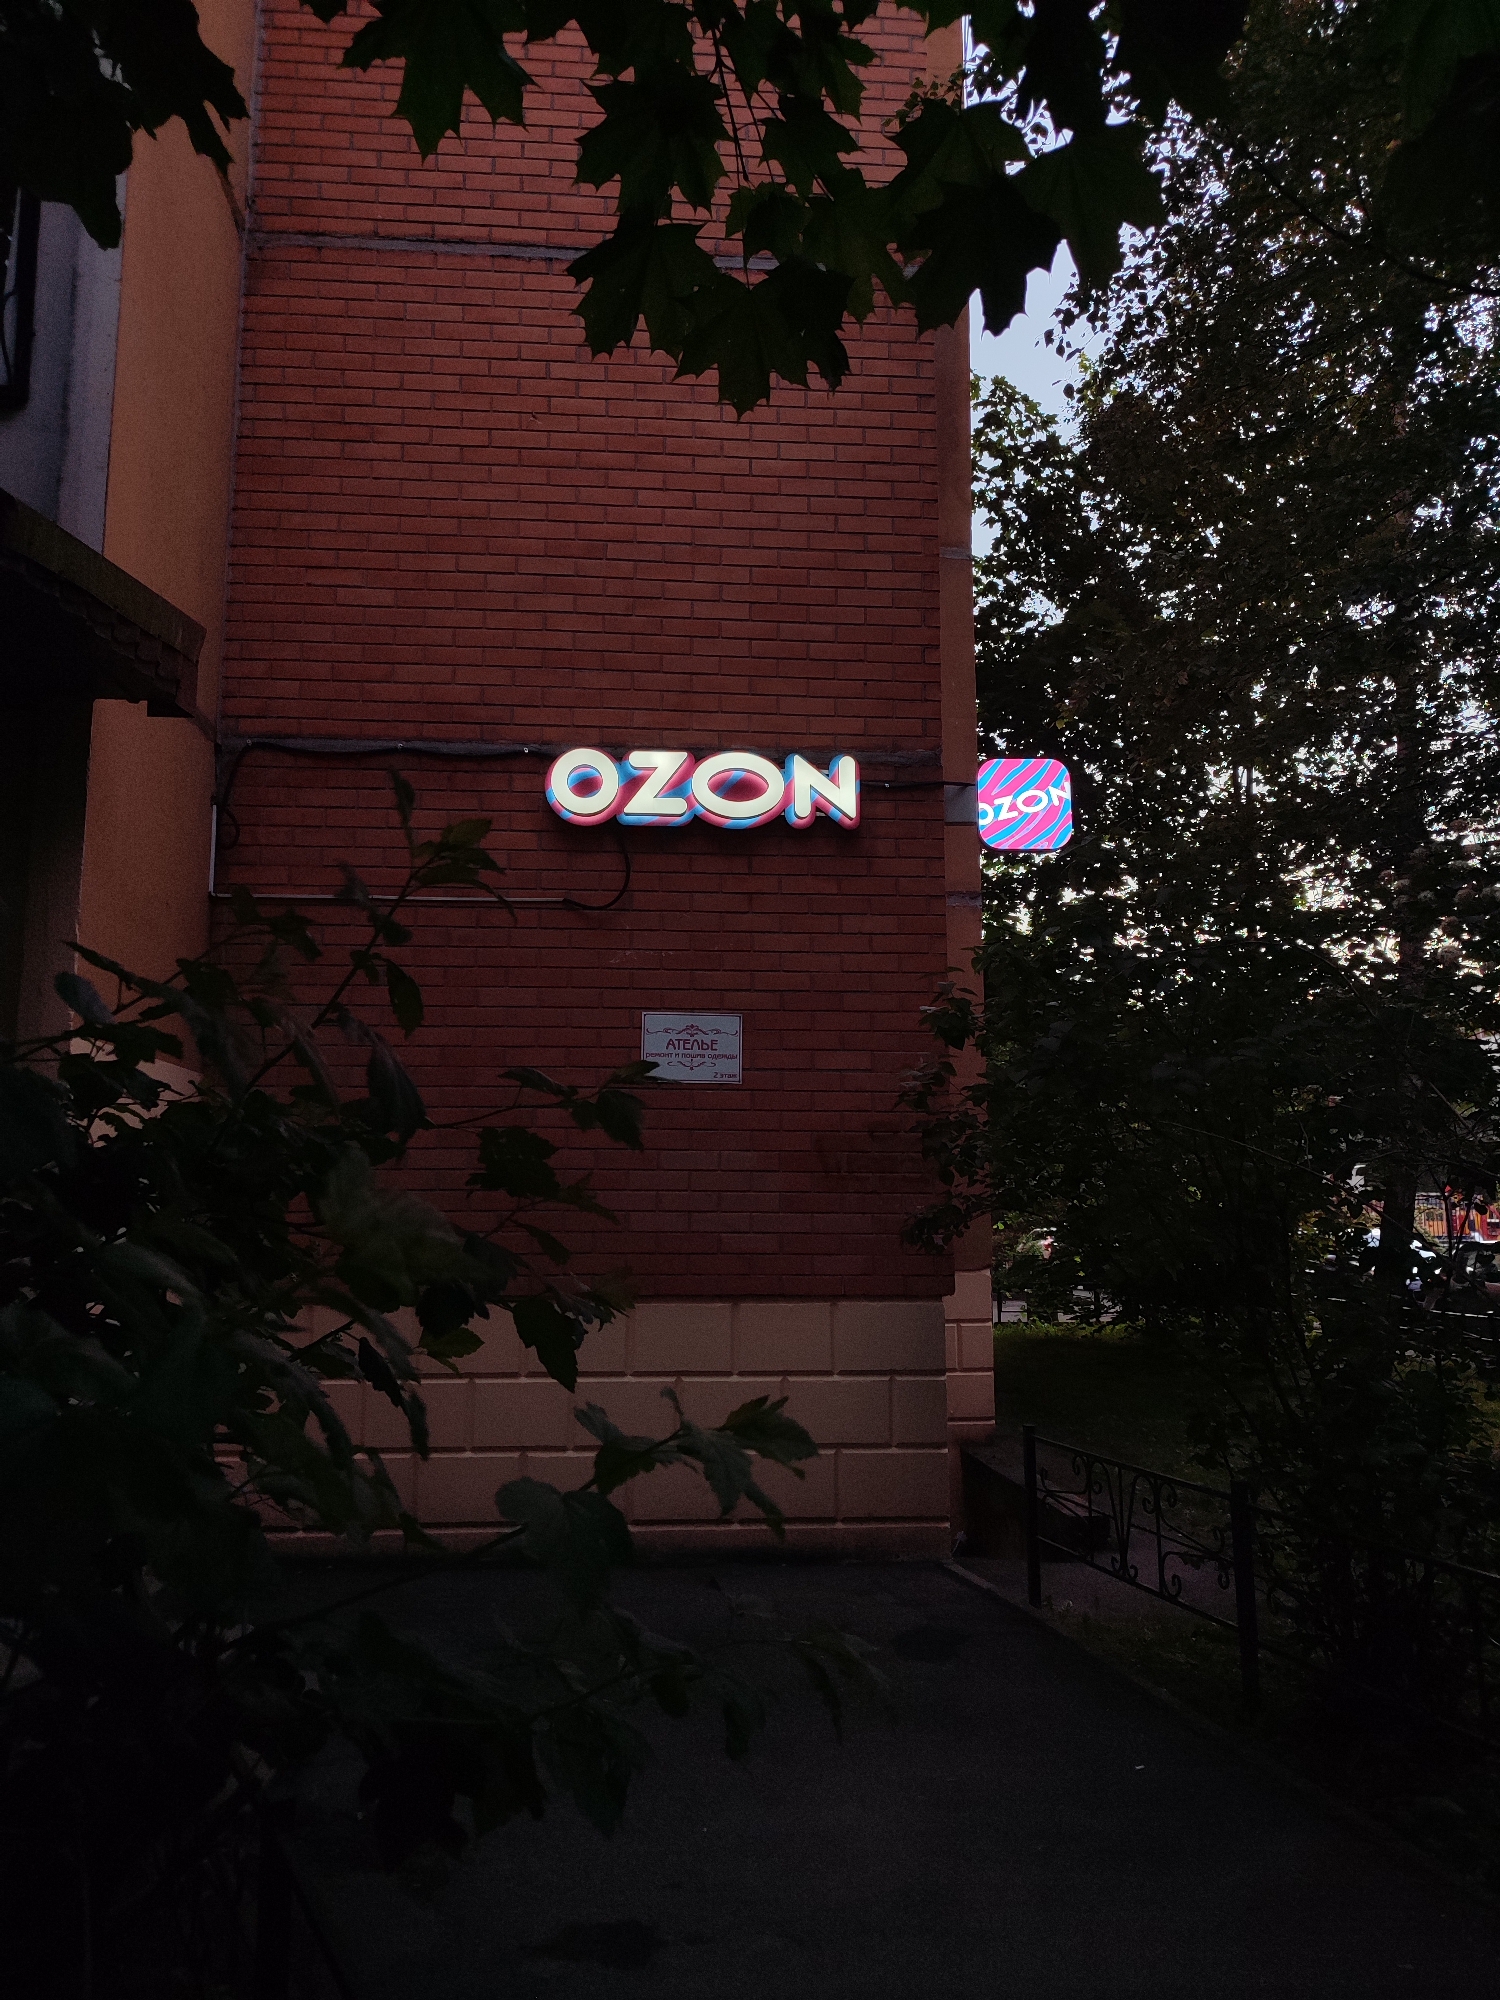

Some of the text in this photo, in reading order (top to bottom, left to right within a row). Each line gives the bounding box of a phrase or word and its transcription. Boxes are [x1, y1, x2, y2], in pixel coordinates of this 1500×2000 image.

[549, 748, 858, 824] OZON
[665, 1038, 718, 1051] АТЕЛЬЕ
[713, 1071, 719, 1079] 2
